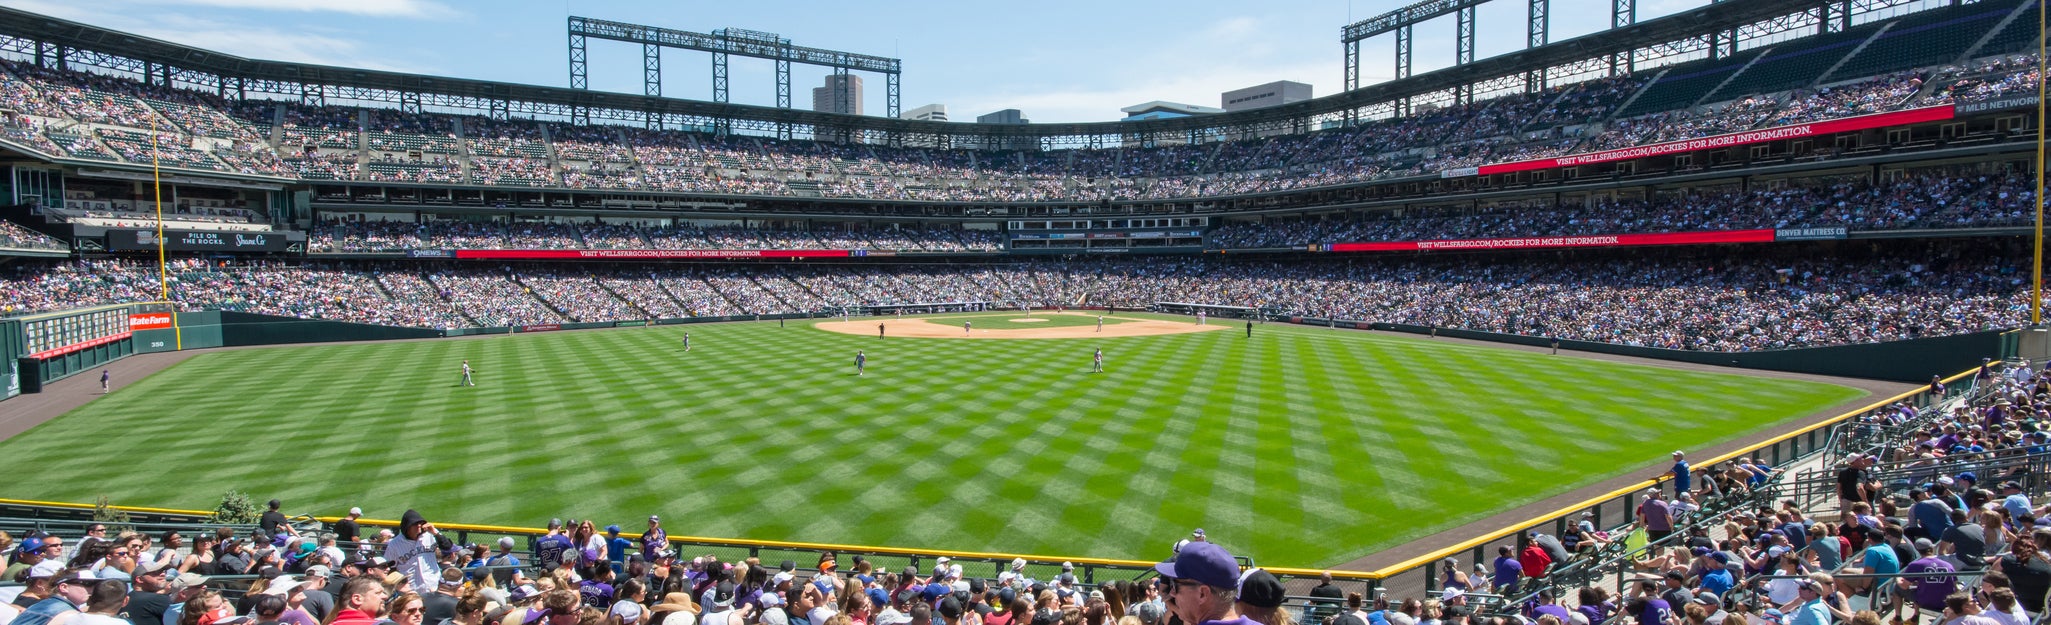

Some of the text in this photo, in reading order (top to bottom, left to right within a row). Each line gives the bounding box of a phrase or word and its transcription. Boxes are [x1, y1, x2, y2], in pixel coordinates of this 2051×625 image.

[1966, 96, 2041, 112] MLB NETWORK
[1556, 126, 1812, 166] VISIT WELLSFARGO.COM/ROCKIES FOR MORE INFORMATION.
[1776, 227, 1847, 237] DENVER MATTRESS CO.
[1433, 239, 1525, 249] WELLSFARGO.COM/ROCKIES
[1525, 238, 1541, 246] FOR
[1541, 237, 1564, 246] MORE
[1565, 236, 1619, 245] INFORMATION.
[150, 315, 170, 324] Farm
[541, 548, 560, 564] 27
[1924, 566, 1949, 584] 27
